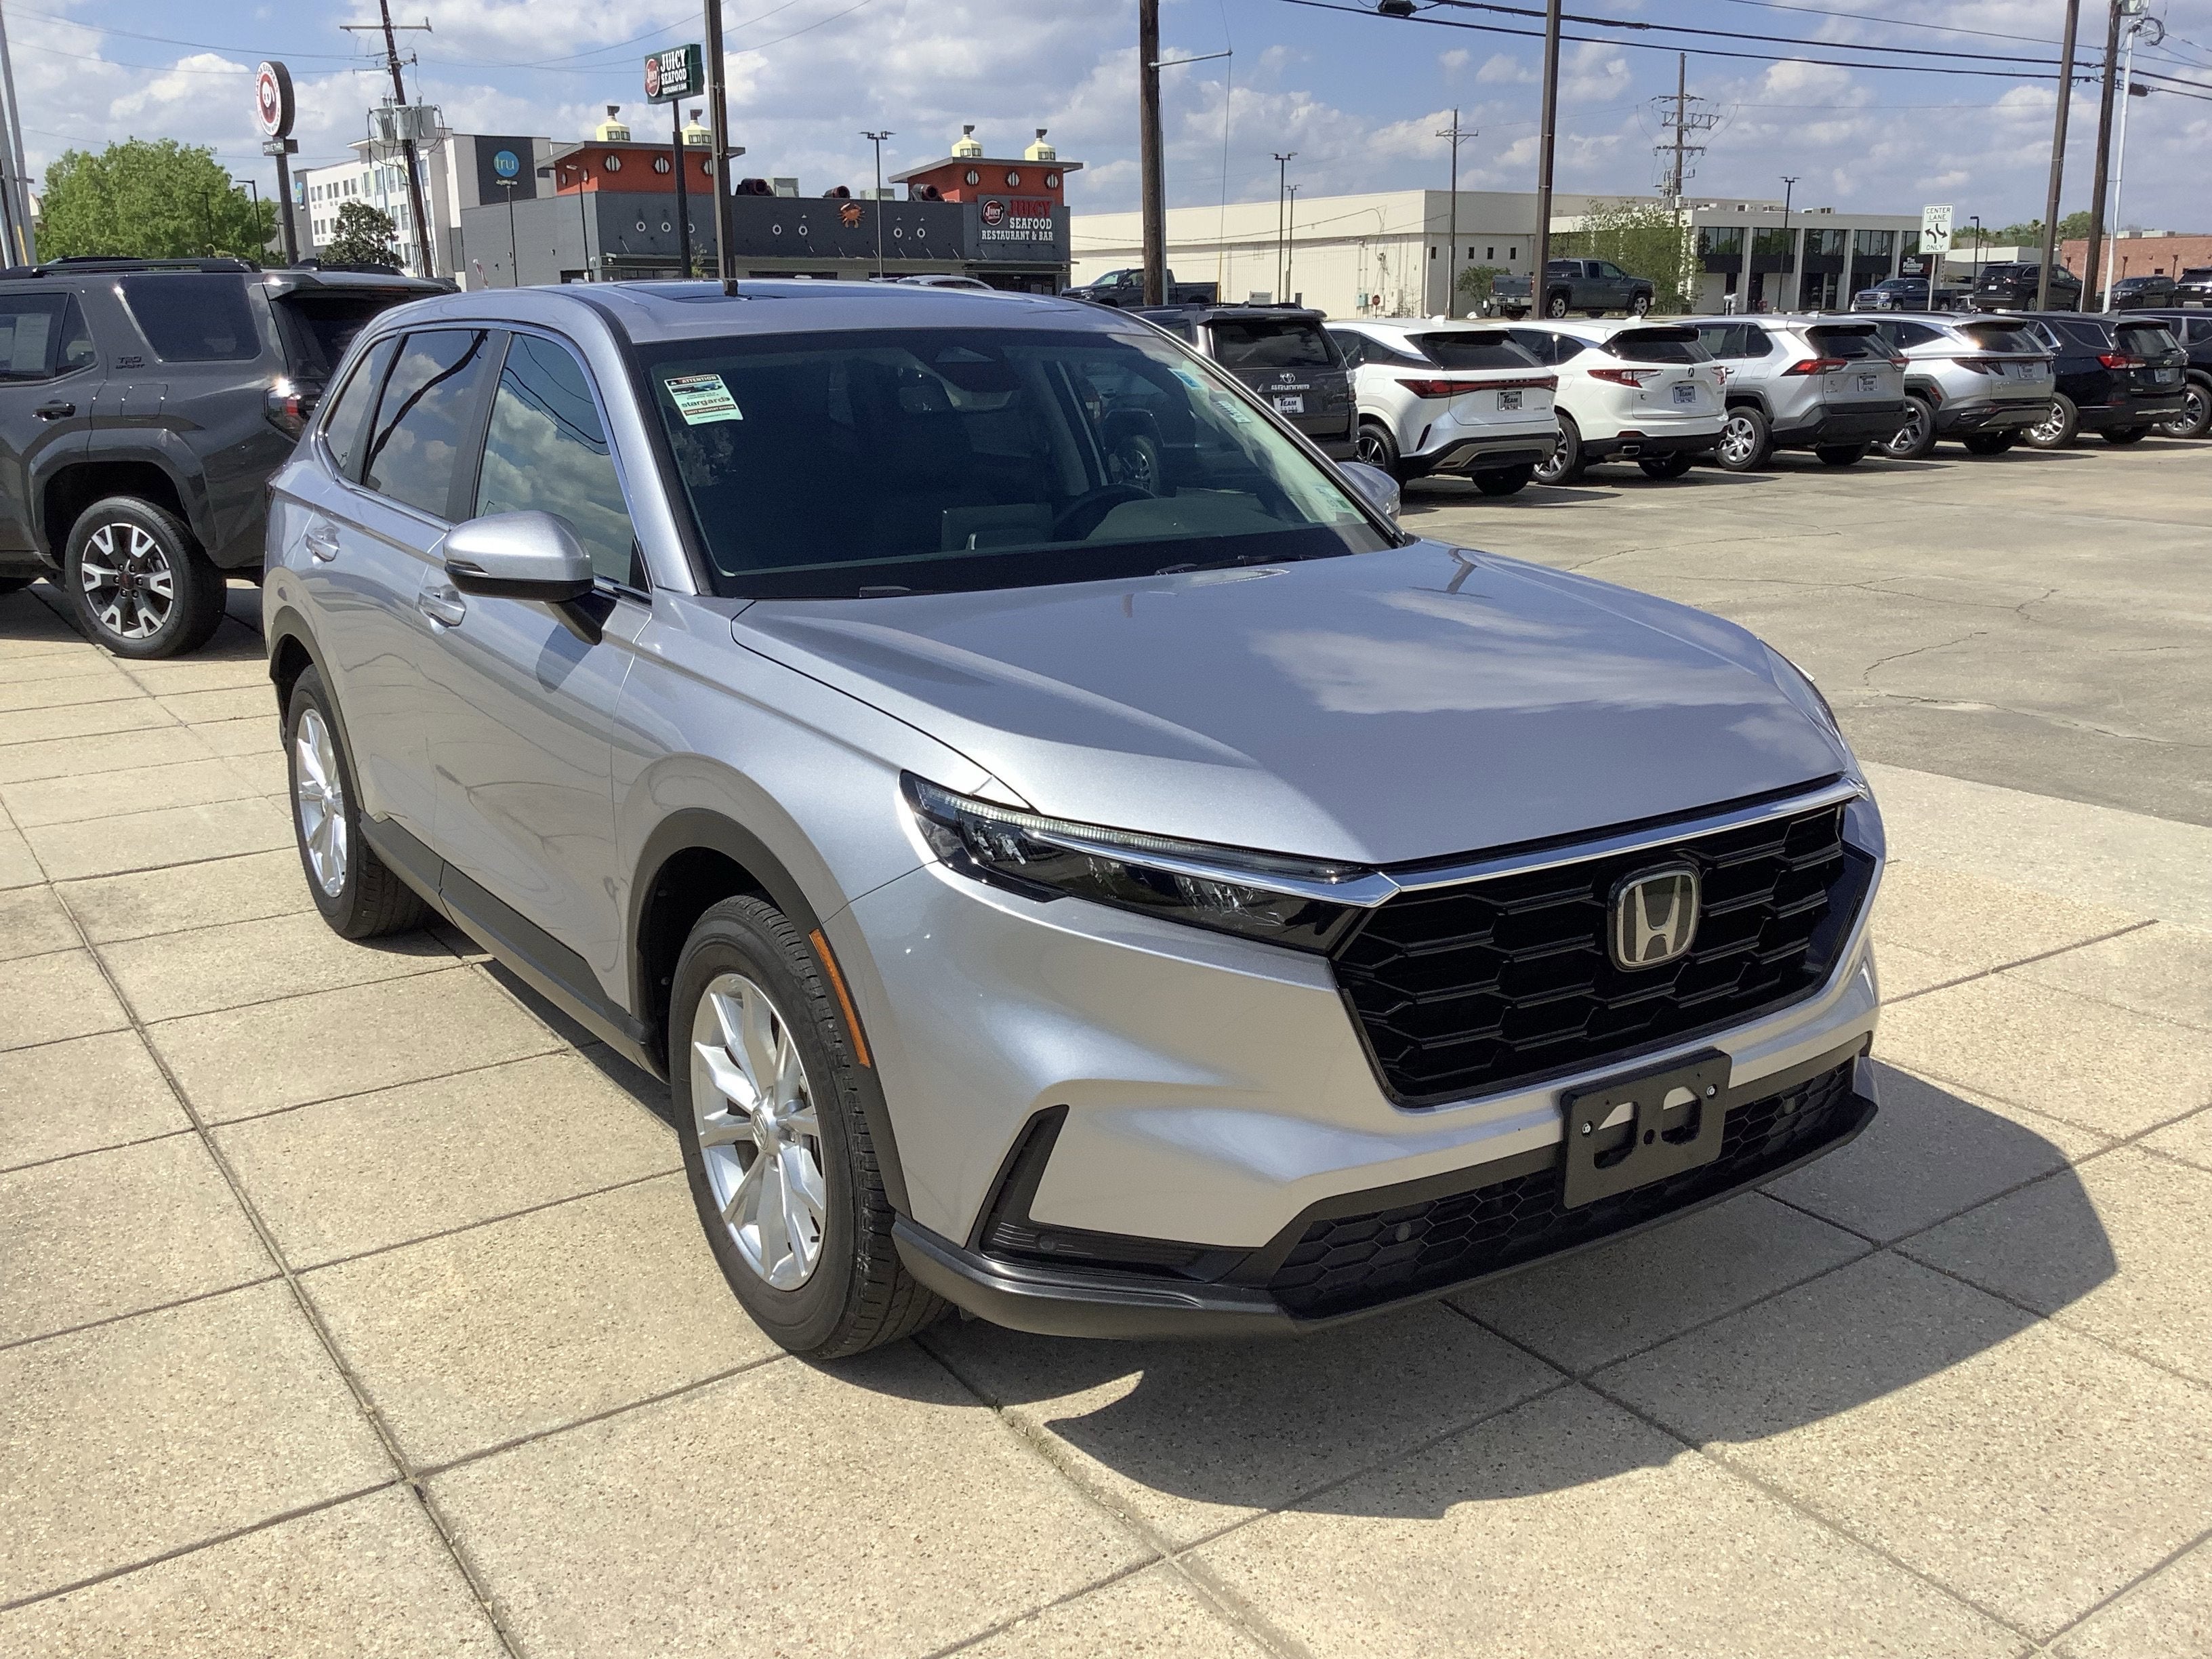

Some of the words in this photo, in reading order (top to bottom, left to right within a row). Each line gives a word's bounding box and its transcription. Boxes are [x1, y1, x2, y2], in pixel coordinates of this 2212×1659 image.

[660, 49, 686, 72] JUICY
[661, 68, 687, 85] SEAFOOD
[495, 155, 514, 170] tru
[1006, 200, 1052, 218] JUICY
[1009, 218, 1052, 230] SEAFOOD
[981, 230, 1029, 241] RESTAURANT
[1031, 231, 1037, 241] &
[1038, 231, 1054, 241] BAR
[682, 375, 716, 384] ATTENTION
[1279, 398, 1296, 407] TEAM
[1503, 395, 1518, 403] TEAM
